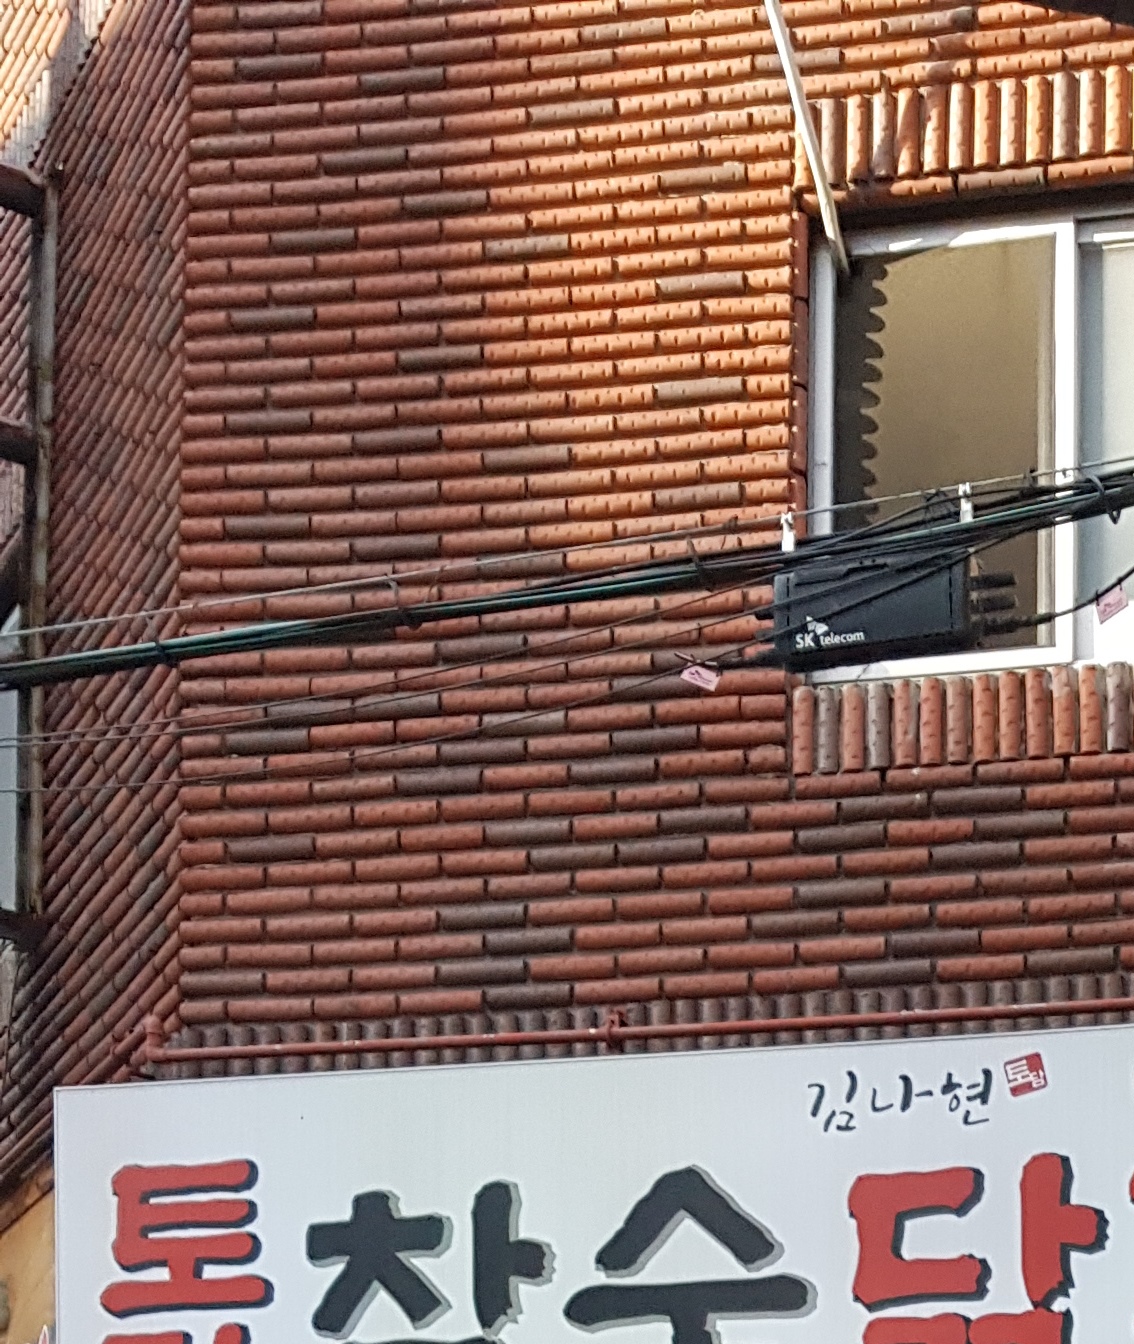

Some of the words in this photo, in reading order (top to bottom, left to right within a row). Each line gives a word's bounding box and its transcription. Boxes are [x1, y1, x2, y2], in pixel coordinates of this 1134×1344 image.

[796, 633, 814, 649] SK
[820, 630, 865, 646] telecom
[807, 1068, 993, 1132] 김나현
